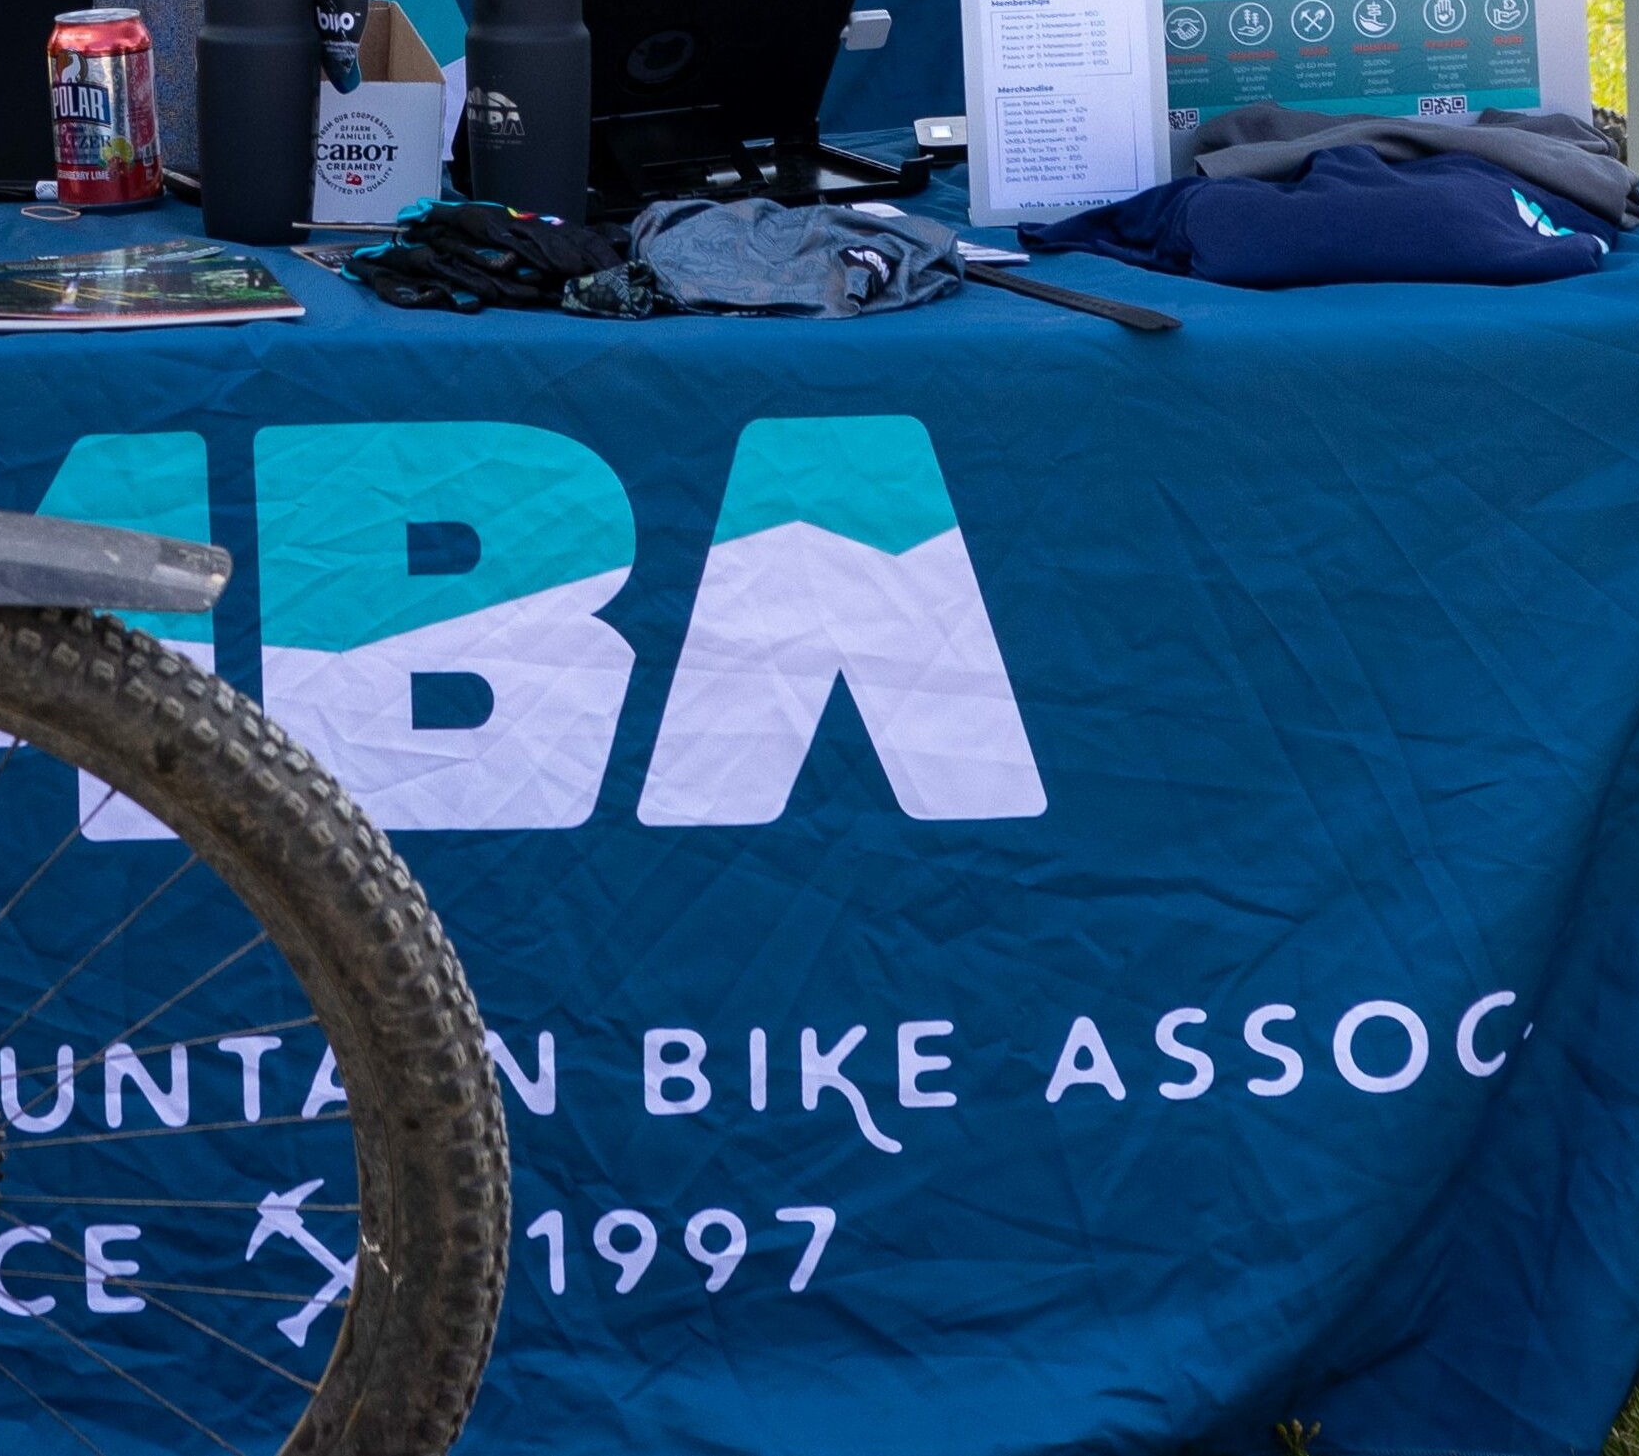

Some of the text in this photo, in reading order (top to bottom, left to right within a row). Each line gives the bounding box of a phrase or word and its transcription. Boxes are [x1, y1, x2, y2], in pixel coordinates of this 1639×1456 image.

[997, 84, 1054, 94] Merchandise
[53, 87, 105, 121] POLAR
[335, 112, 395, 140] OUR COOPERATIVE
[326, 162, 383, 171] CREAMERY
[366, 167, 394, 193] QUALITY
[643, 1019, 964, 1155] BIKE
[525, 1202, 844, 1300] 1997
